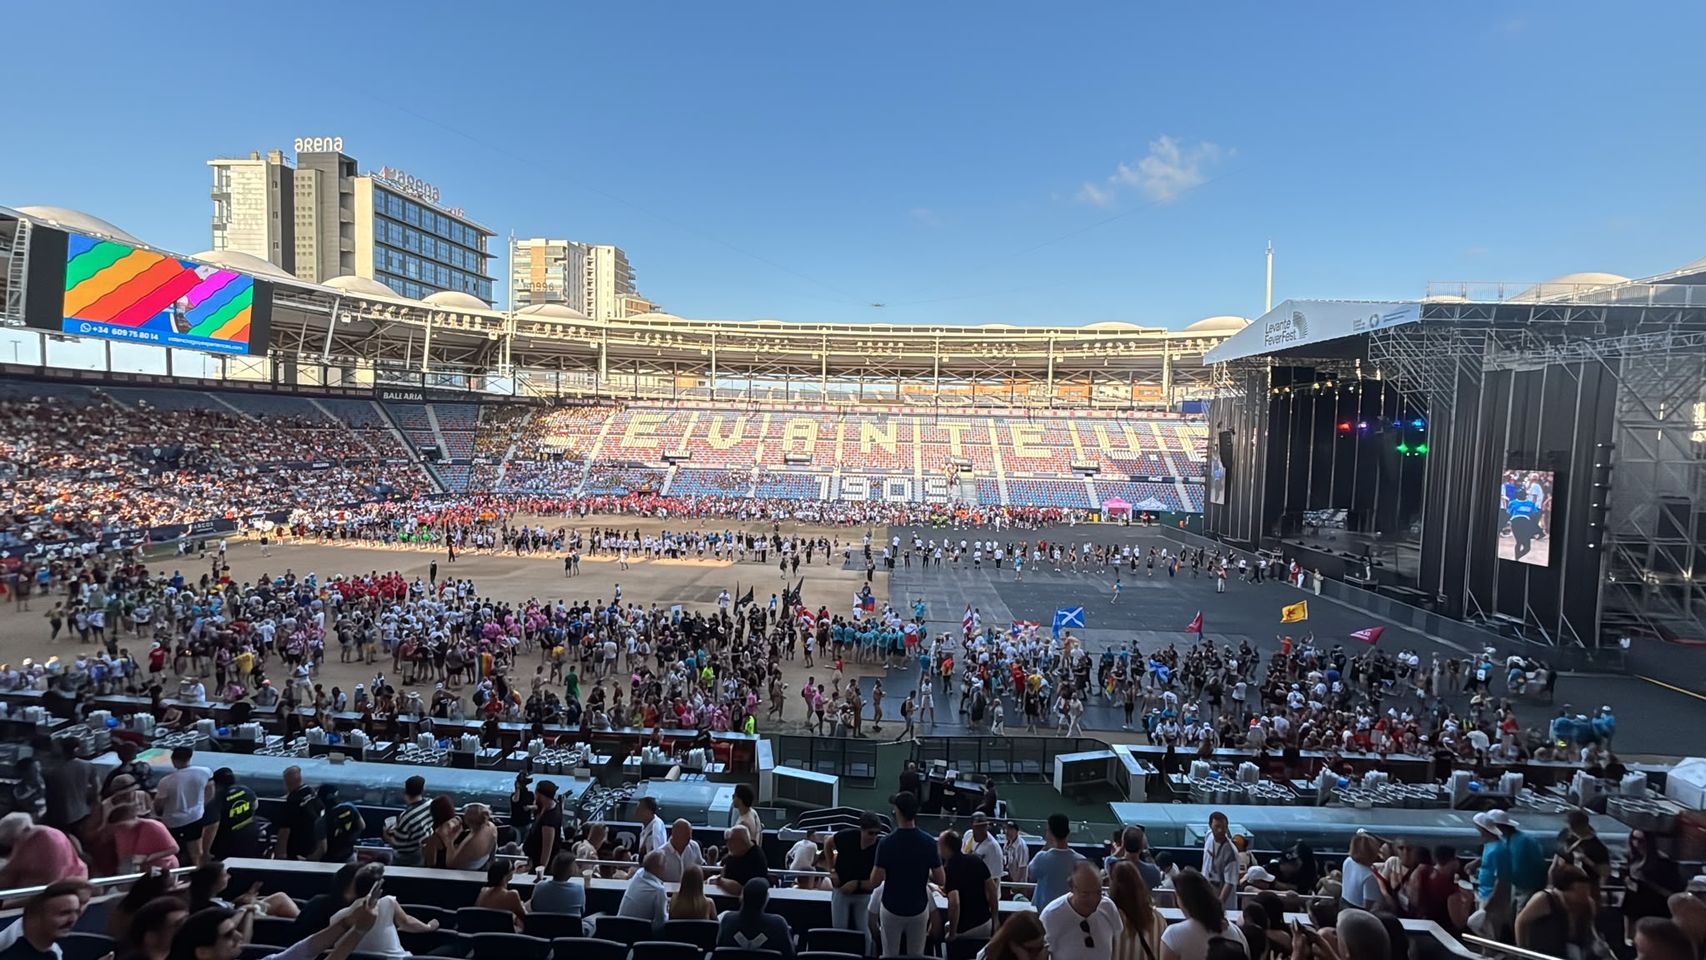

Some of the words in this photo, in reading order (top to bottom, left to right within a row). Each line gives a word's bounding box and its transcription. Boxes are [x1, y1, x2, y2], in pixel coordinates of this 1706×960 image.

[294, 136, 343, 152] arena
[92, 325, 108, 334] +34
[111, 327, 128, 336] 609
[129, 330, 138, 338] 75
[150, 333, 159, 341] 14
[1265, 319, 1291, 334] Levante
